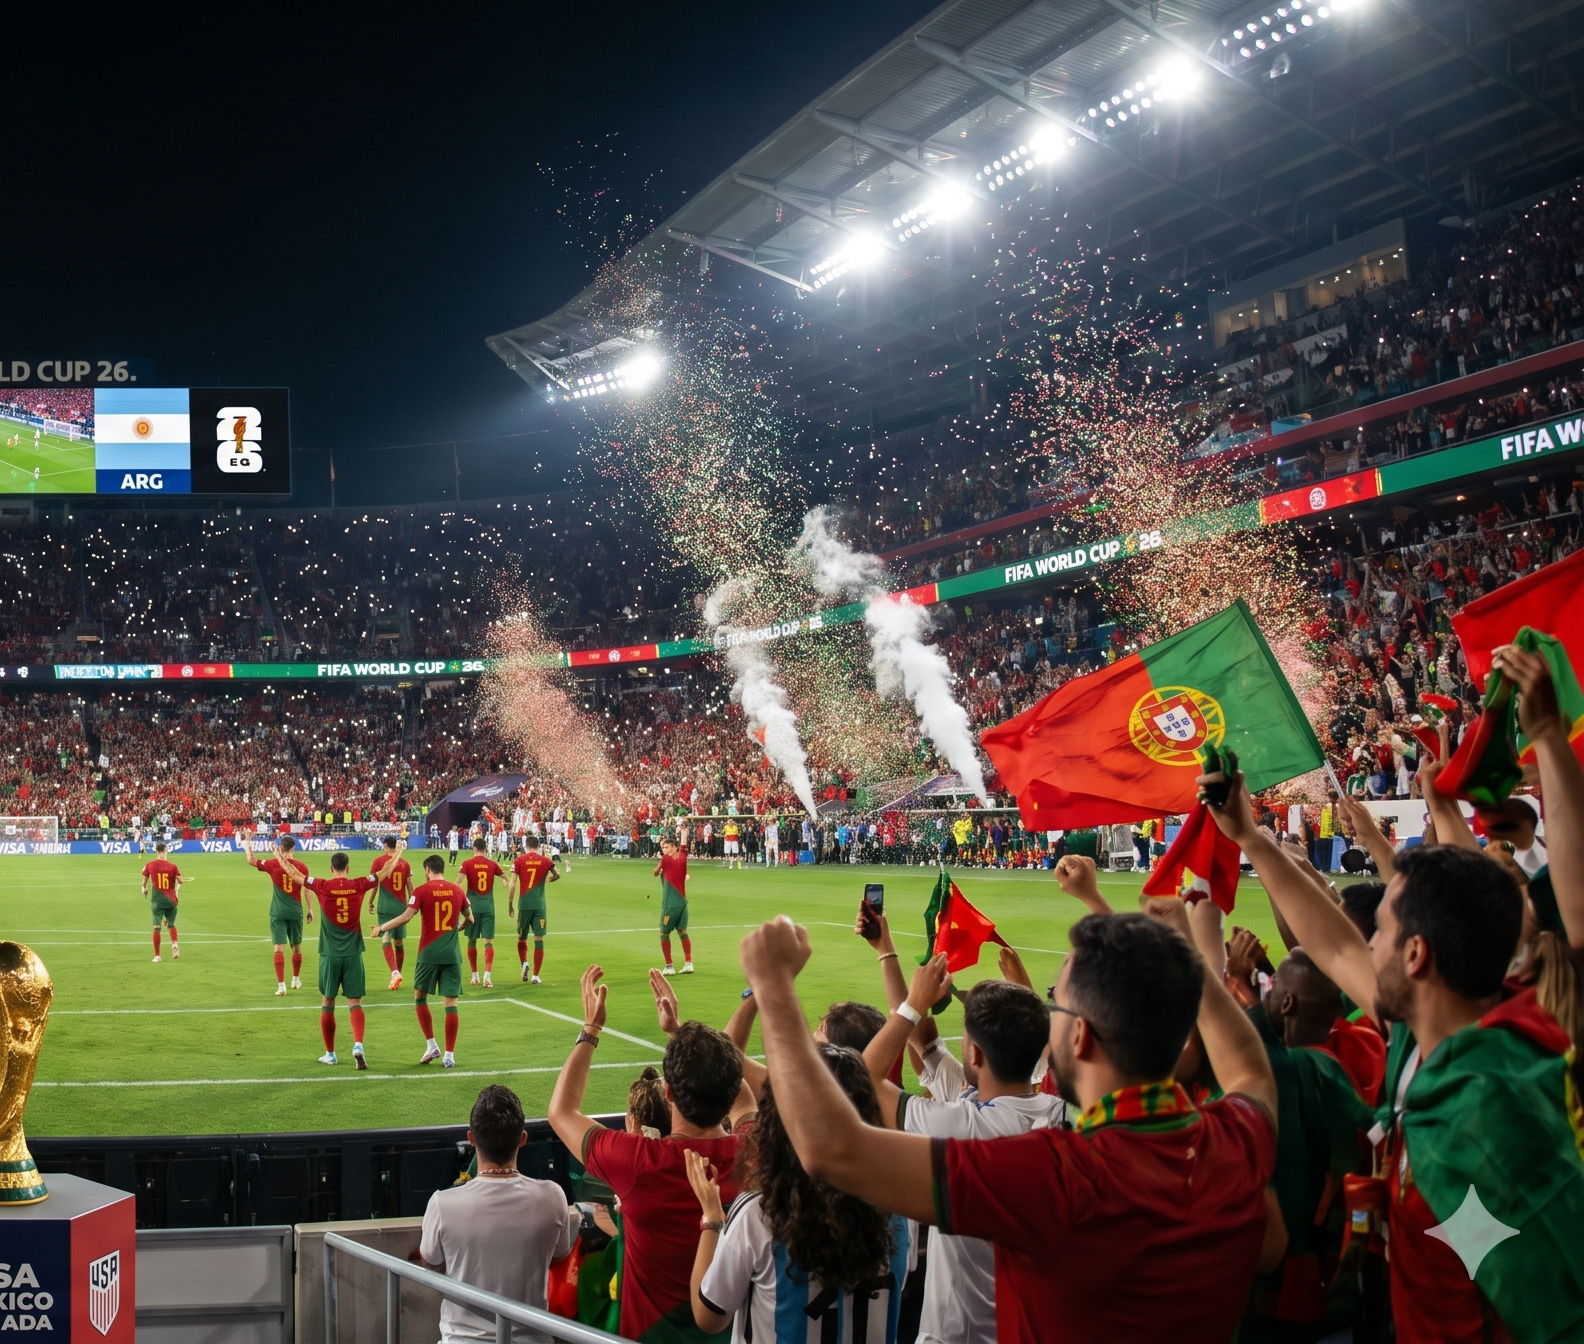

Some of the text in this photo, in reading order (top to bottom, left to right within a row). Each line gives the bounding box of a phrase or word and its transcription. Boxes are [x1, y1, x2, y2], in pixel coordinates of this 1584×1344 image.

[37, 361, 90, 382] CUP
[97, 361, 137, 382] 26.
[1501, 418, 1584, 460] FIFA W
[230, 458, 250, 466] EG
[121, 474, 163, 489] ARG
[1005, 563, 1033, 583] FIFA
[1035, 549, 1086, 576] WORLD
[1089, 540, 1120, 563] CUP
[318, 664, 352, 676] FIFA
[353, 663, 410, 675] WORLD
[414, 661, 445, 673] CUP
[99, 842, 131, 853] VISA
[200, 841, 232, 852] VISA
[157, 872, 169, 890] 16
[392, 872, 402, 892] 9
[477, 871, 487, 891] 8
[526, 868, 536, 889] 7
[434, 900, 453, 931] 12
[91, 1254, 117, 1290] USA
